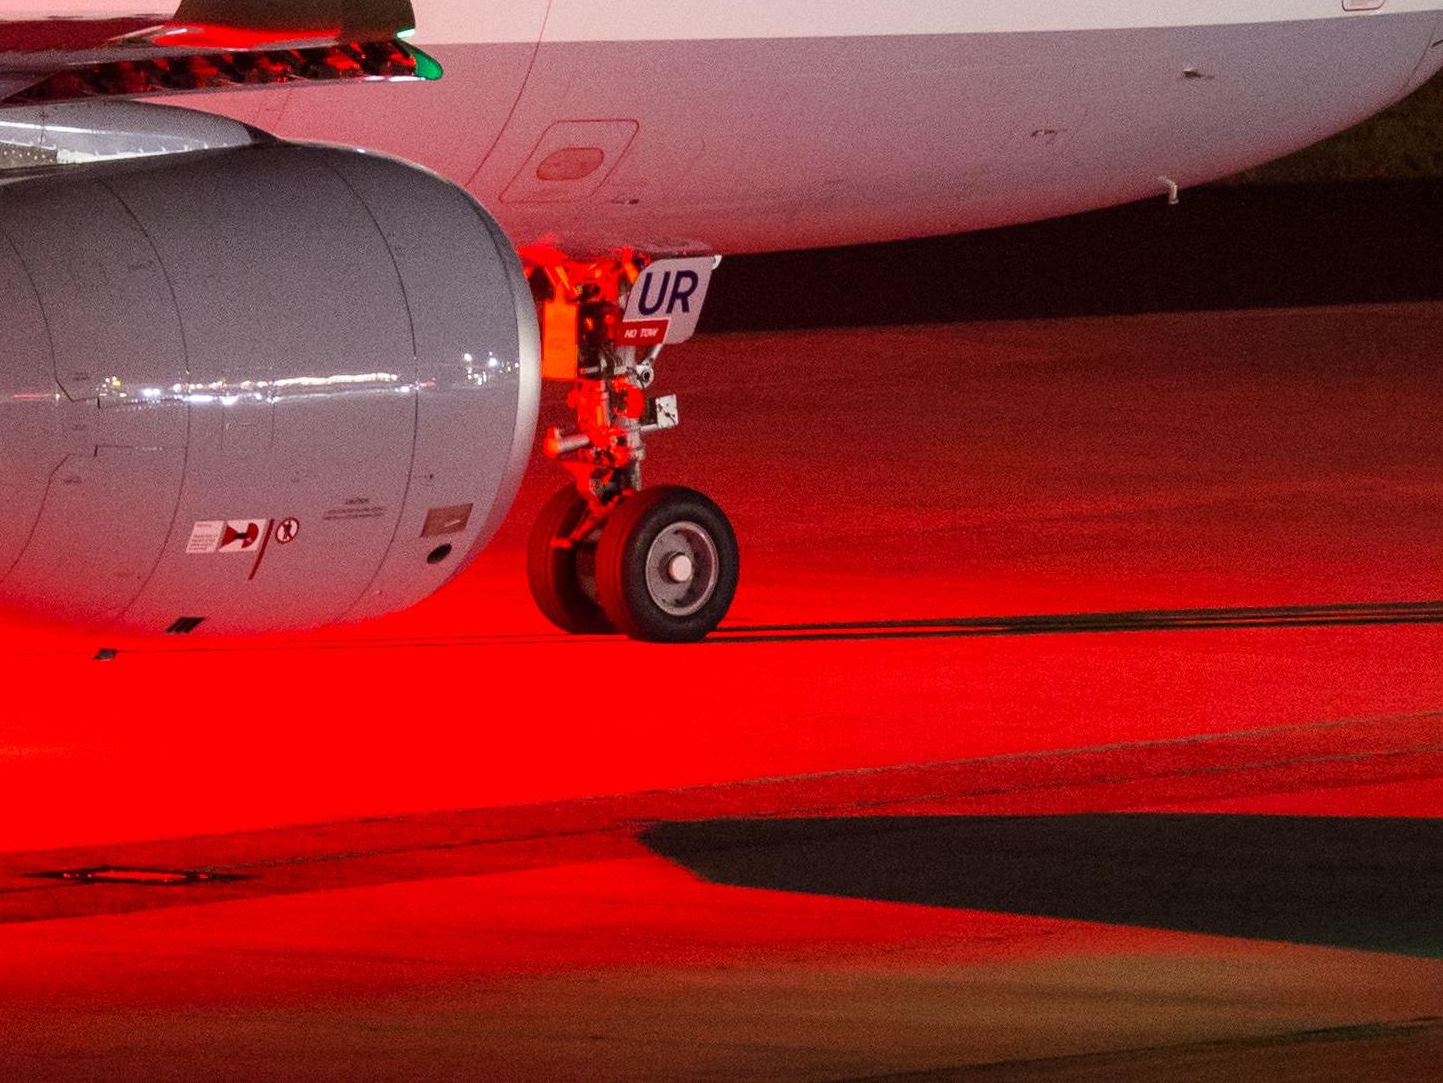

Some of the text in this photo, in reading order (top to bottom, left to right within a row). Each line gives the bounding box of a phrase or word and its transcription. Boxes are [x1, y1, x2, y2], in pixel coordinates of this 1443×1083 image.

[638, 270, 699, 315] UR
[624, 328, 659, 338] NO TOW
